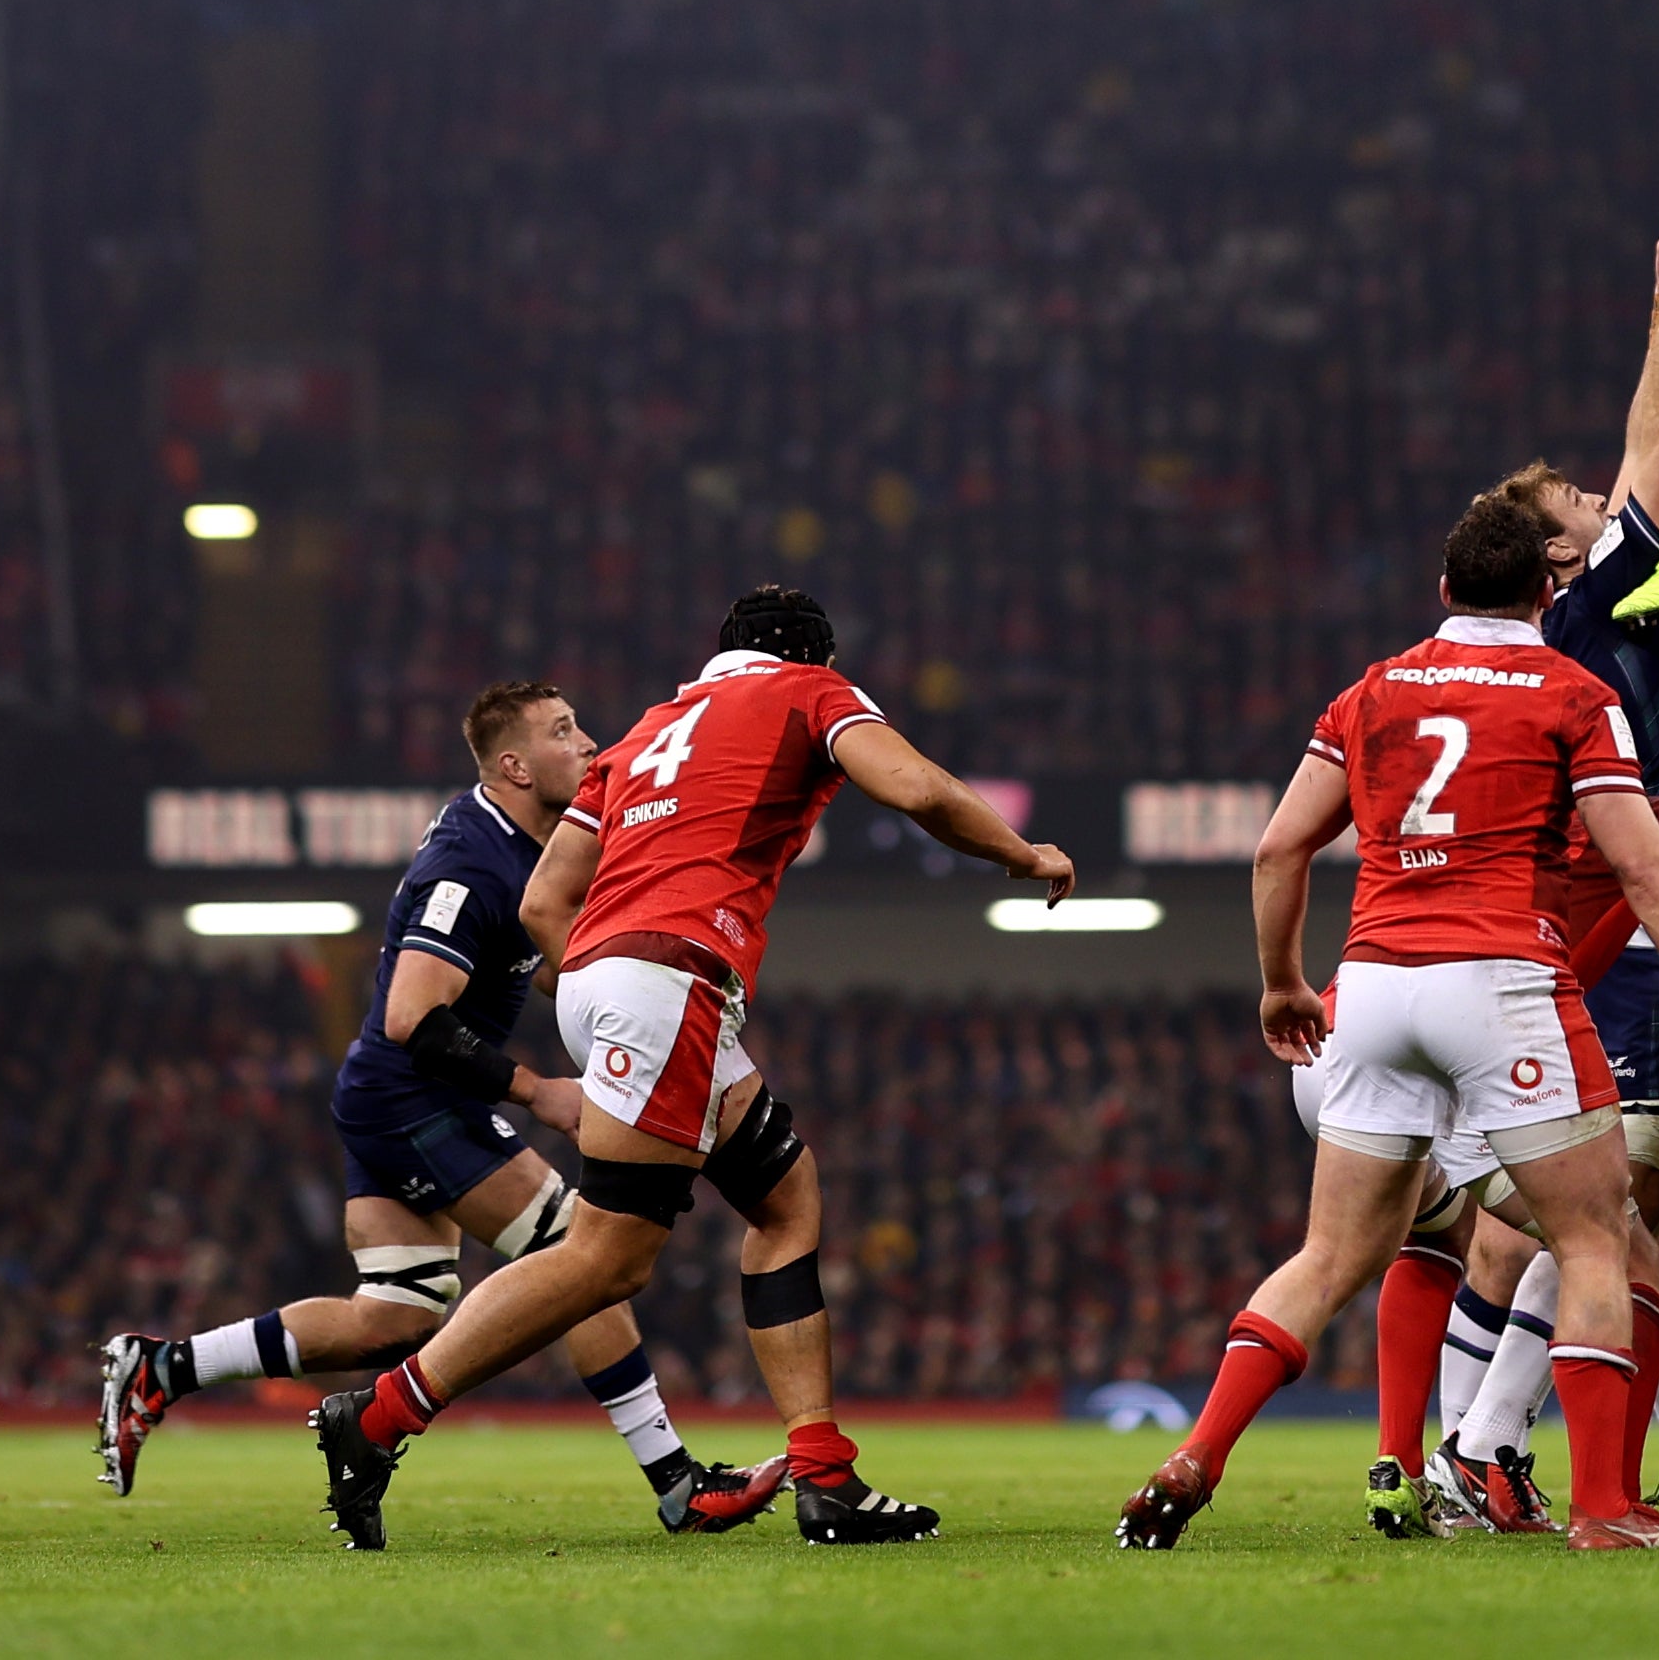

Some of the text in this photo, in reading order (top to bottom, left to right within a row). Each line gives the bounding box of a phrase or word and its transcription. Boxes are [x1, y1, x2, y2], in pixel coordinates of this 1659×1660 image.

[628, 695, 712, 789] 4
[1400, 714, 1470, 835] 2
[621, 797, 679, 829] JENKINS
[1399, 848, 1448, 870] ELIAS
[593, 1069, 633, 1100] vodafone
[1509, 1086, 1562, 1108] vodafone
